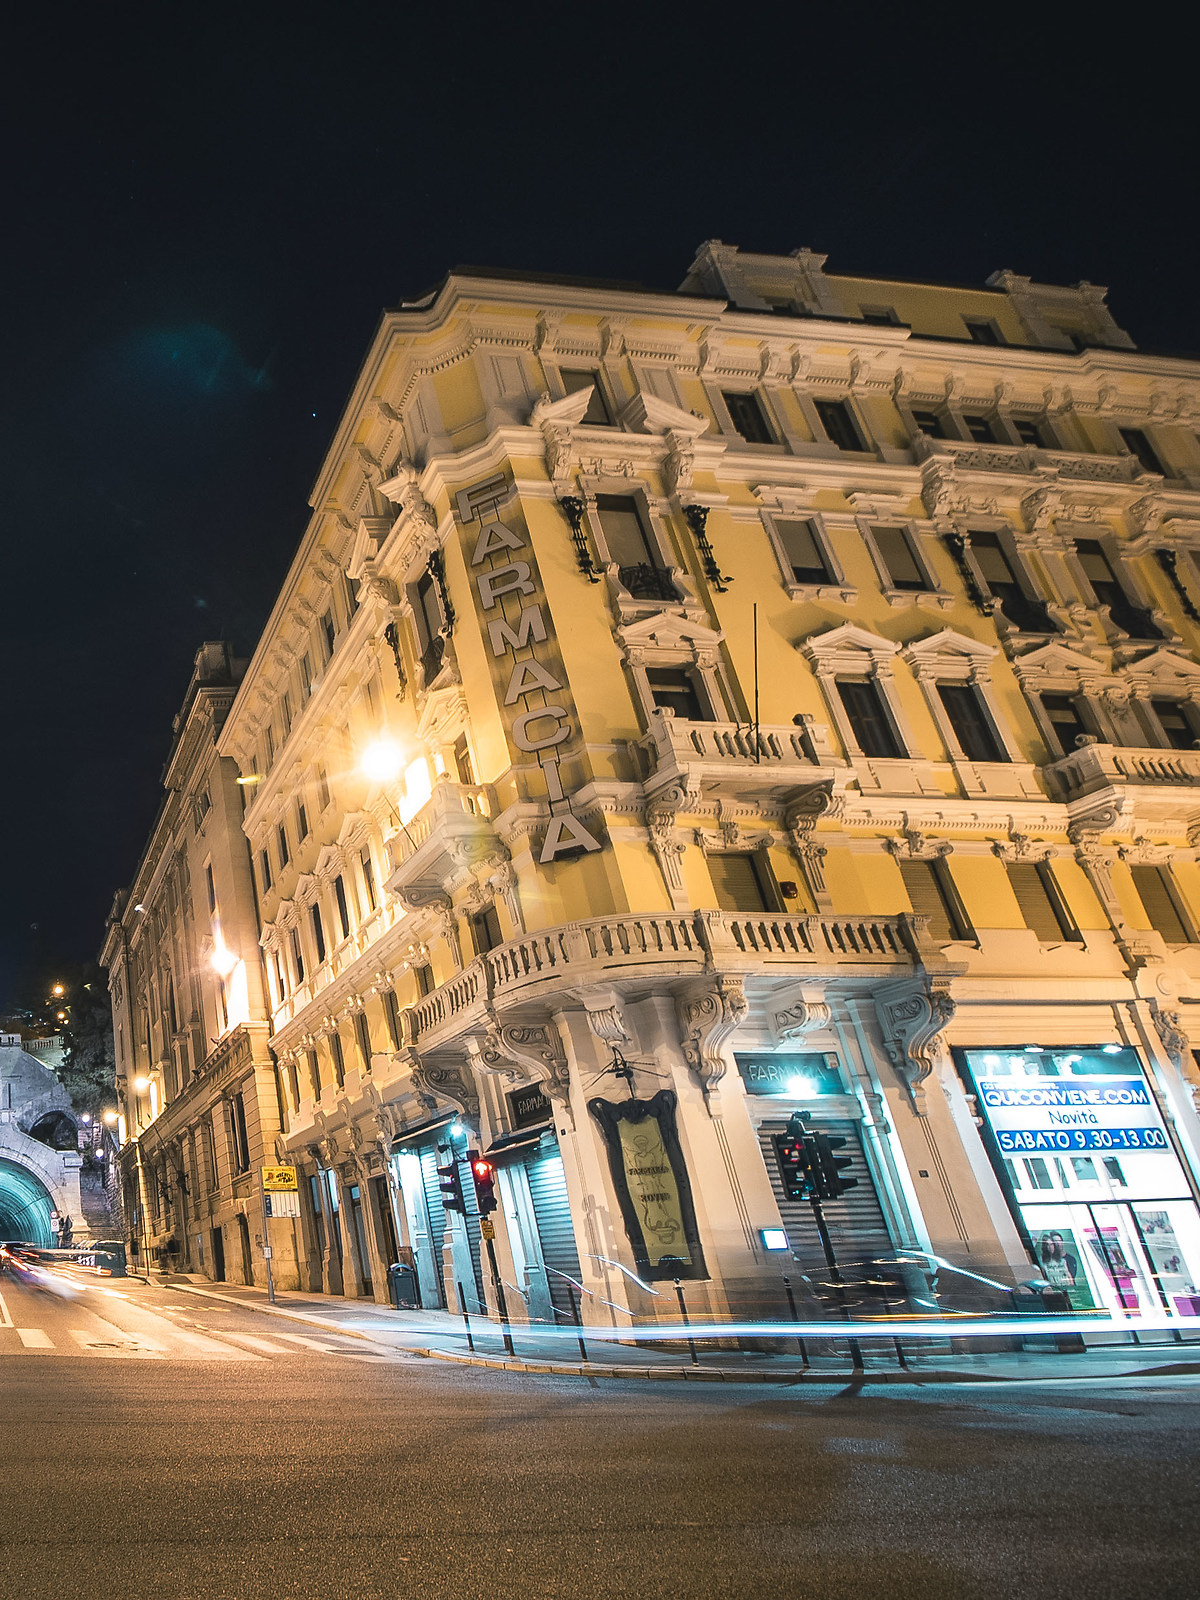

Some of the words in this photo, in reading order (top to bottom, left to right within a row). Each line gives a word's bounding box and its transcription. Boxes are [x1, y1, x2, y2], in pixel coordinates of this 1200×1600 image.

[455, 472, 601, 864] FARMACIA
[985, 1089, 1148, 1106] QUICONVIENE.COM
[1048, 1109, 1099, 1125] Novità
[1001, 1131, 1070, 1150] SABATO
